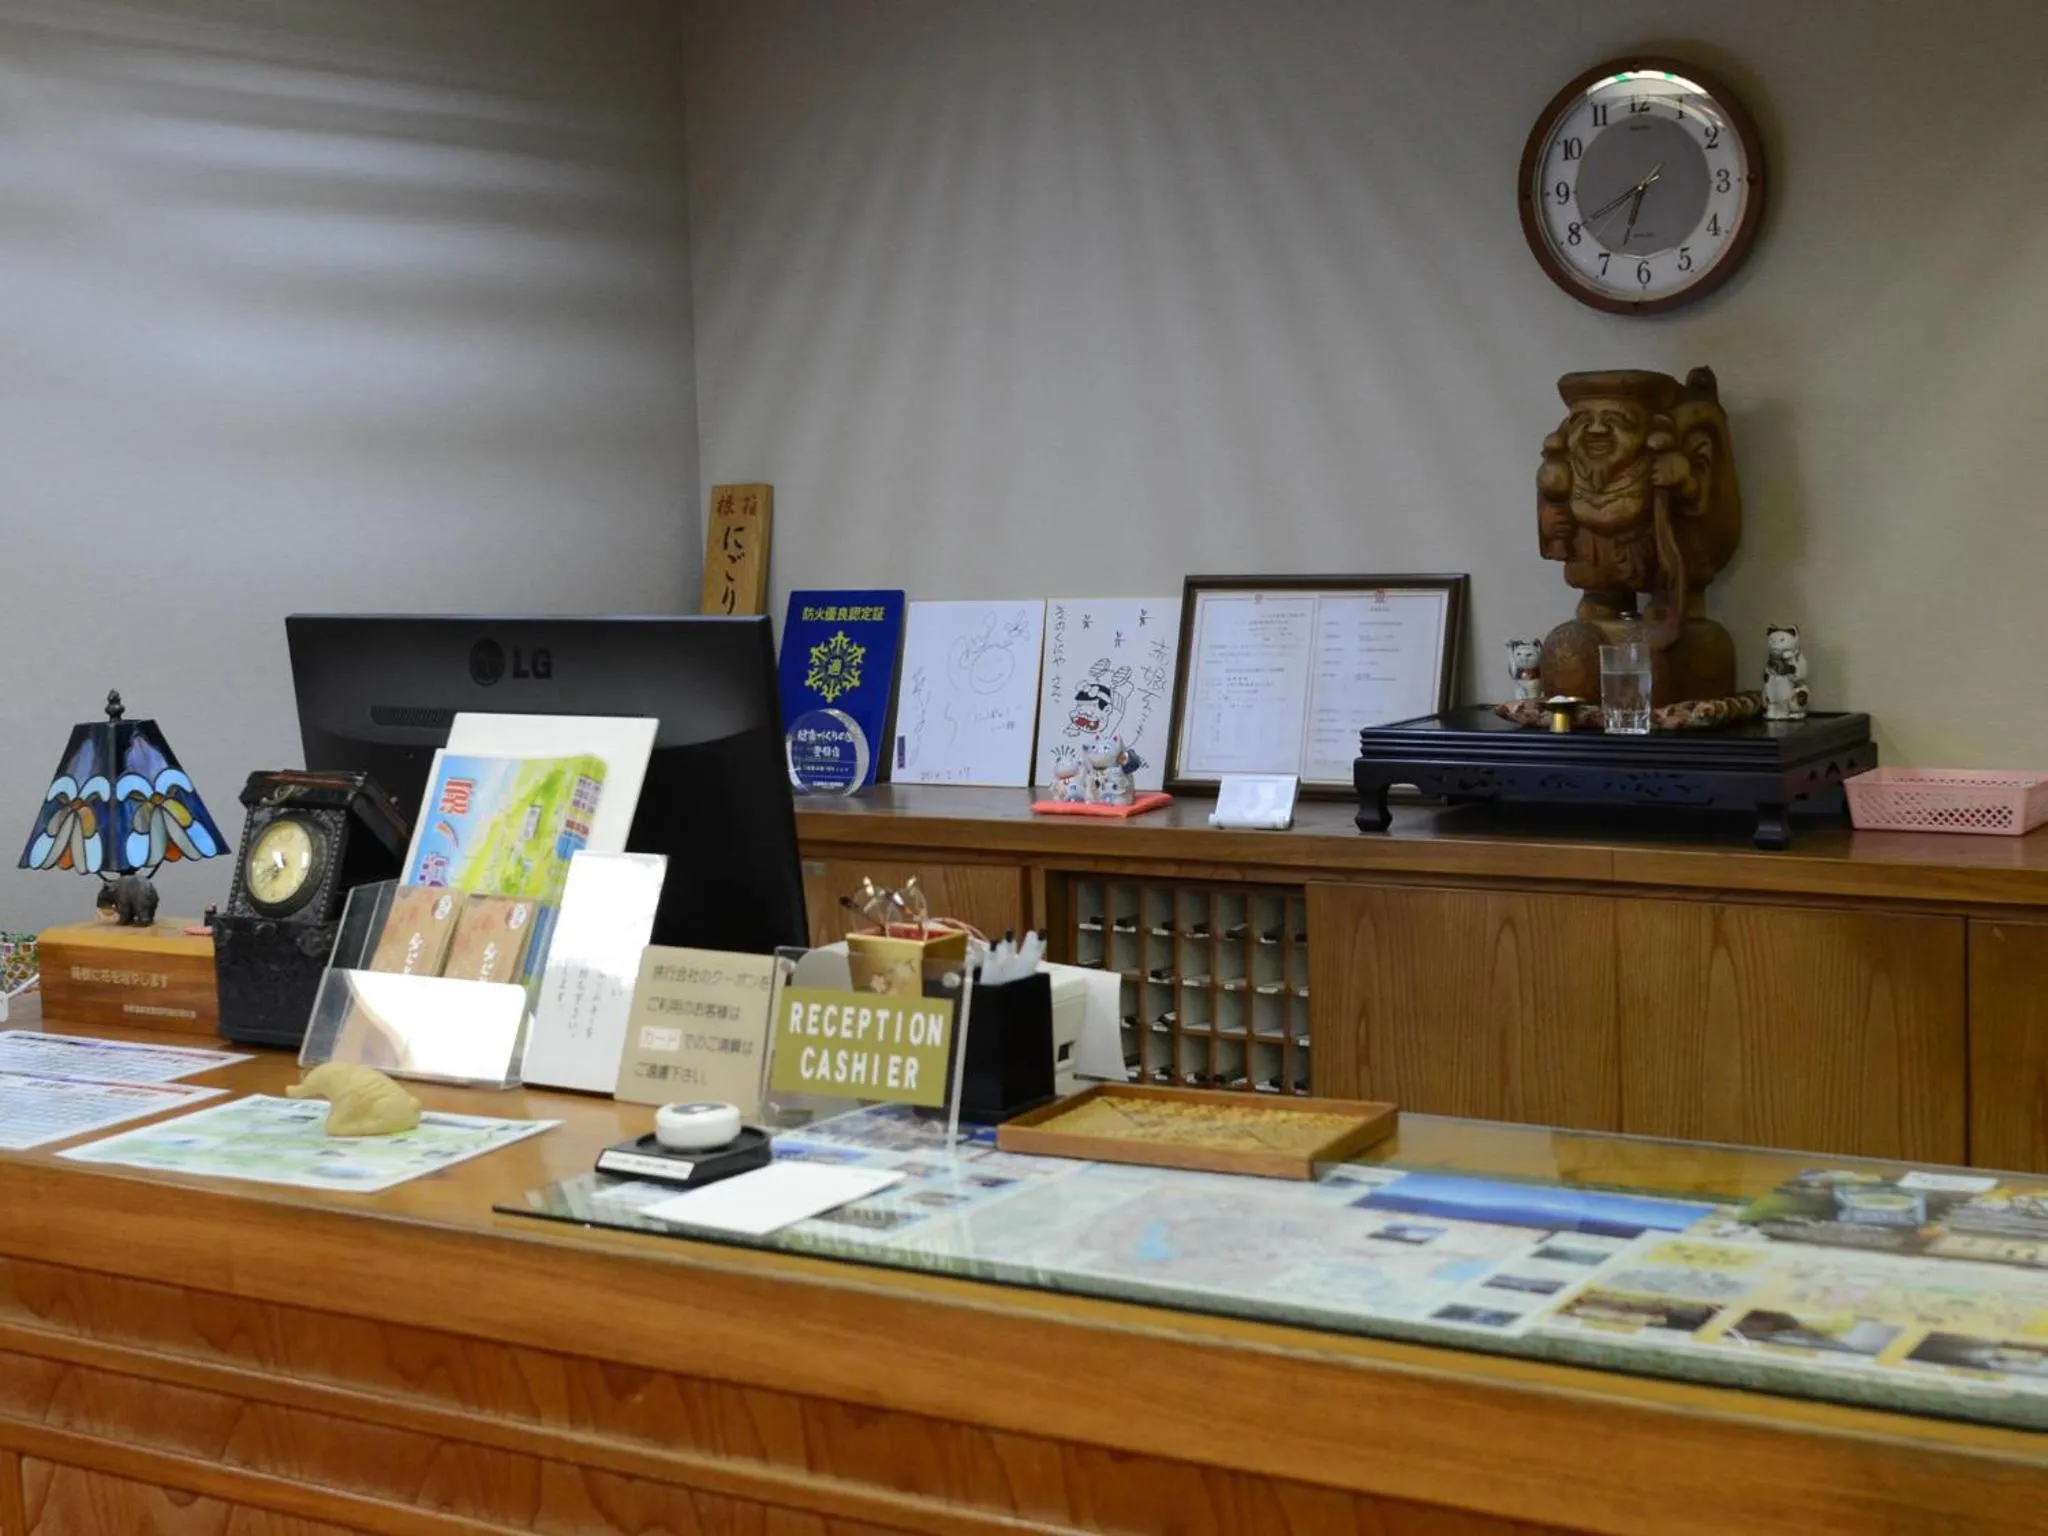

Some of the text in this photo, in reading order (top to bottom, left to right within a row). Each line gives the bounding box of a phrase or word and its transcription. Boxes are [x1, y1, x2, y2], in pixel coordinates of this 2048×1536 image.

[1592, 104, 1608, 127] 11
[1628, 97, 1651, 114] 12
[1562, 137, 1583, 162] 10
[1704, 125, 1720, 150] 2
[1555, 181, 1570, 205] 9
[1715, 168, 1731, 193] 3
[1567, 221, 1582, 246] 8
[1706, 212, 1721, 237] 4
[1598, 252, 1612, 277] 7
[1636, 259, 1651, 285] 6
[1677, 247, 1692, 272] 5
[512, 648, 552, 680] LG
[788, 1001, 945, 1048] RECEPTION
[800, 1046, 920, 1091] CASHIER
